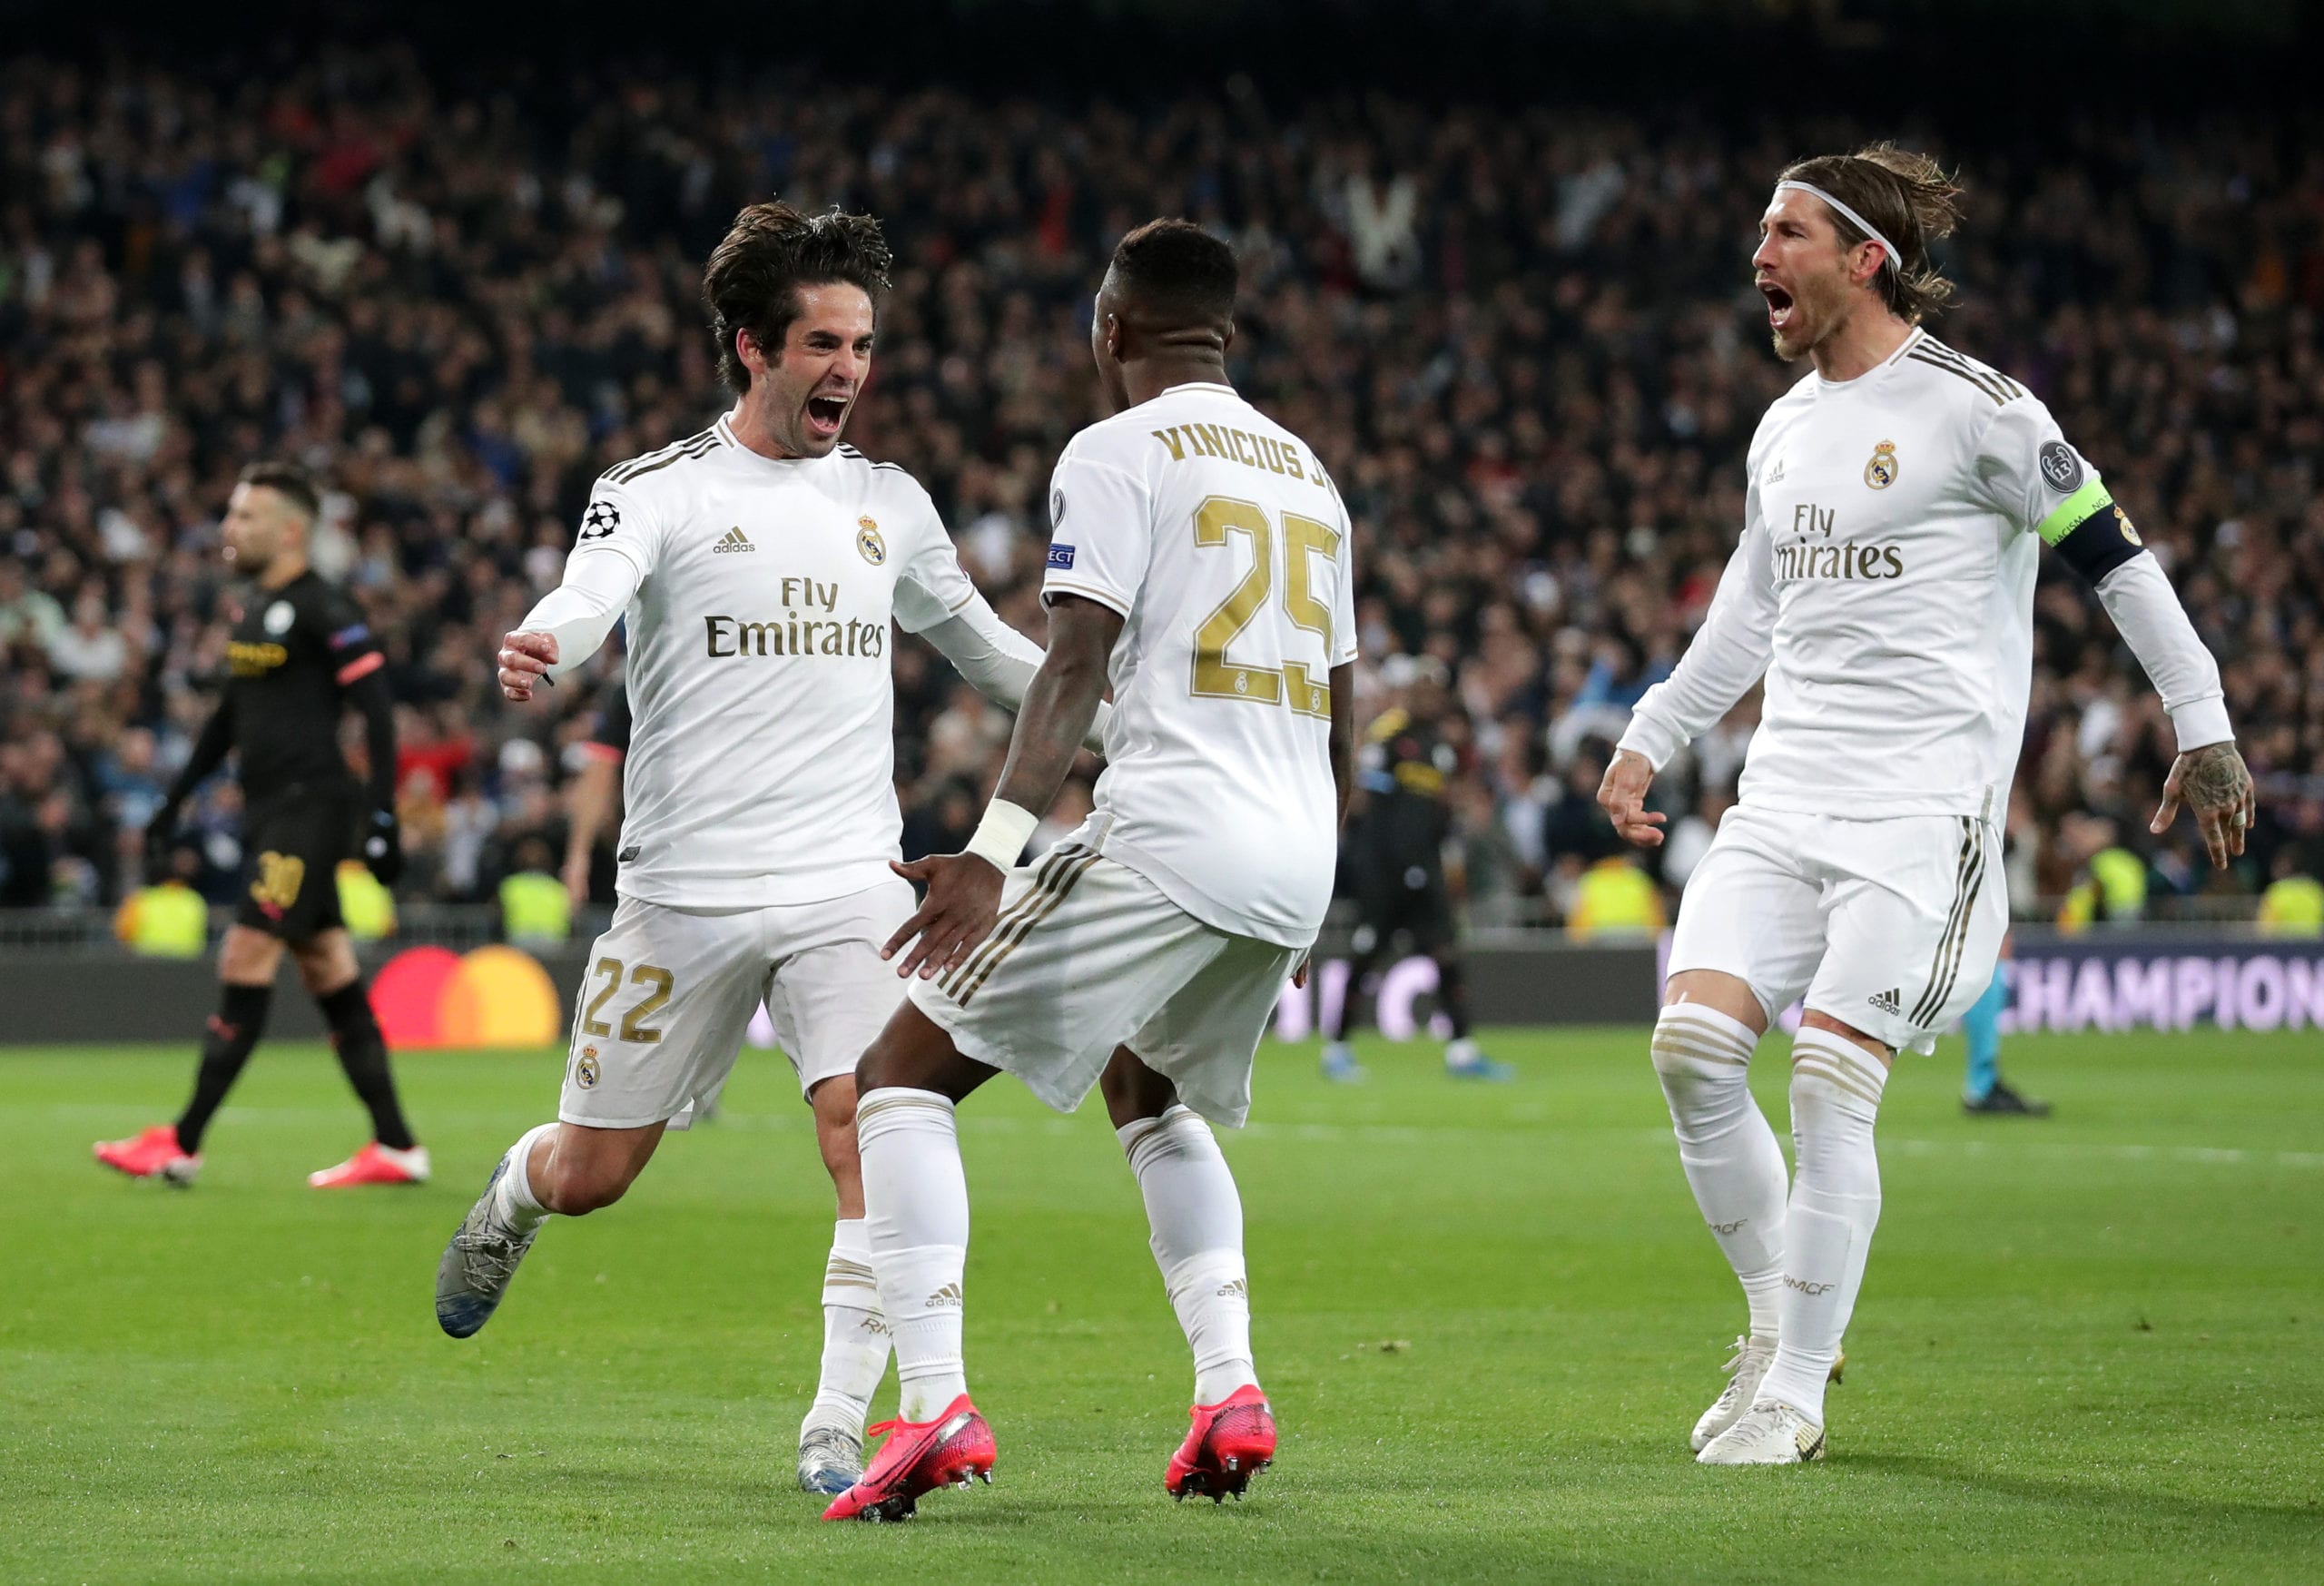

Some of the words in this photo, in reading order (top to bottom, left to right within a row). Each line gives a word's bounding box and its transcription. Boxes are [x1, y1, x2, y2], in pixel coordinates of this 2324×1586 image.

[1152, 422, 1305, 480] VINICIUS
[2054, 460, 2072, 480] 13
[1793, 503, 1835, 537] Fly
[713, 543, 755, 554] adidas
[1776, 536, 1903, 579] mirates
[781, 577, 838, 613] Fly
[1190, 494, 1341, 723] 25
[704, 611, 885, 658] Emirates
[581, 956, 674, 1043] 22
[1867, 996, 1900, 1016] adidas
[1709, 1218, 1748, 1235] MCF
[1783, 1274, 1836, 1295] RMCF
